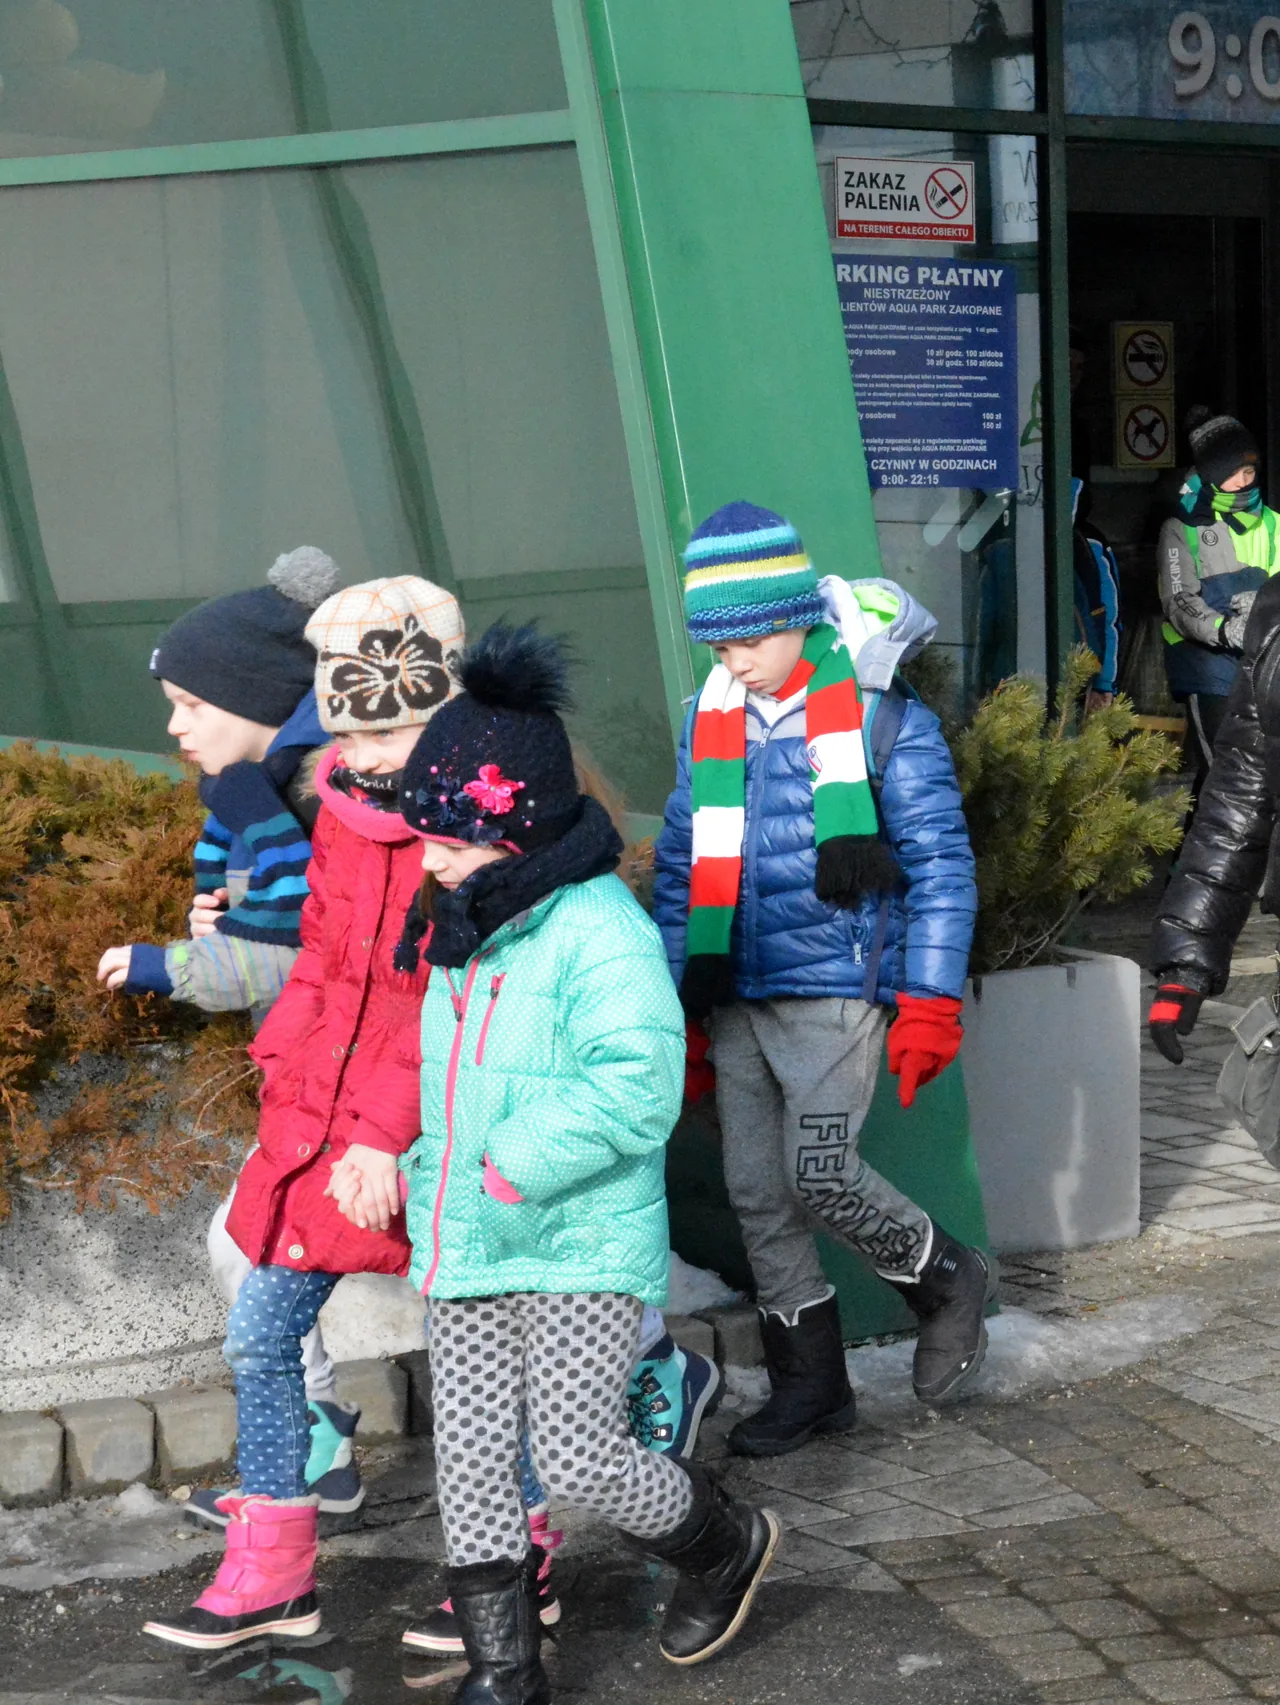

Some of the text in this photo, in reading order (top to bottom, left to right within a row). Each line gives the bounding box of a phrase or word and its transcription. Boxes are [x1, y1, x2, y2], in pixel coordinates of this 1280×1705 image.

[844, 171, 905, 190] ZAKAZ
[845, 192, 920, 212] PALENIA
[844, 224, 968, 237] NA TERENIE CAŁEGO OBIEKTU
[836, 264, 1004, 287] RKING PŁATNY
[864, 287, 950, 300] NIESTRZEŻONY
[889, 304, 917, 313] AQUA
[920, 304, 946, 314] PARK
[949, 304, 1002, 315] ZAKOPANE
[945, 350, 964, 358] godz.
[945, 359, 964, 367] godz.
[871, 460, 997, 470] CZYNNY W GODZINACH
[881, 474, 939, 485] 9:00- 22:15
[1168, 548, 1182, 595] SKIING
